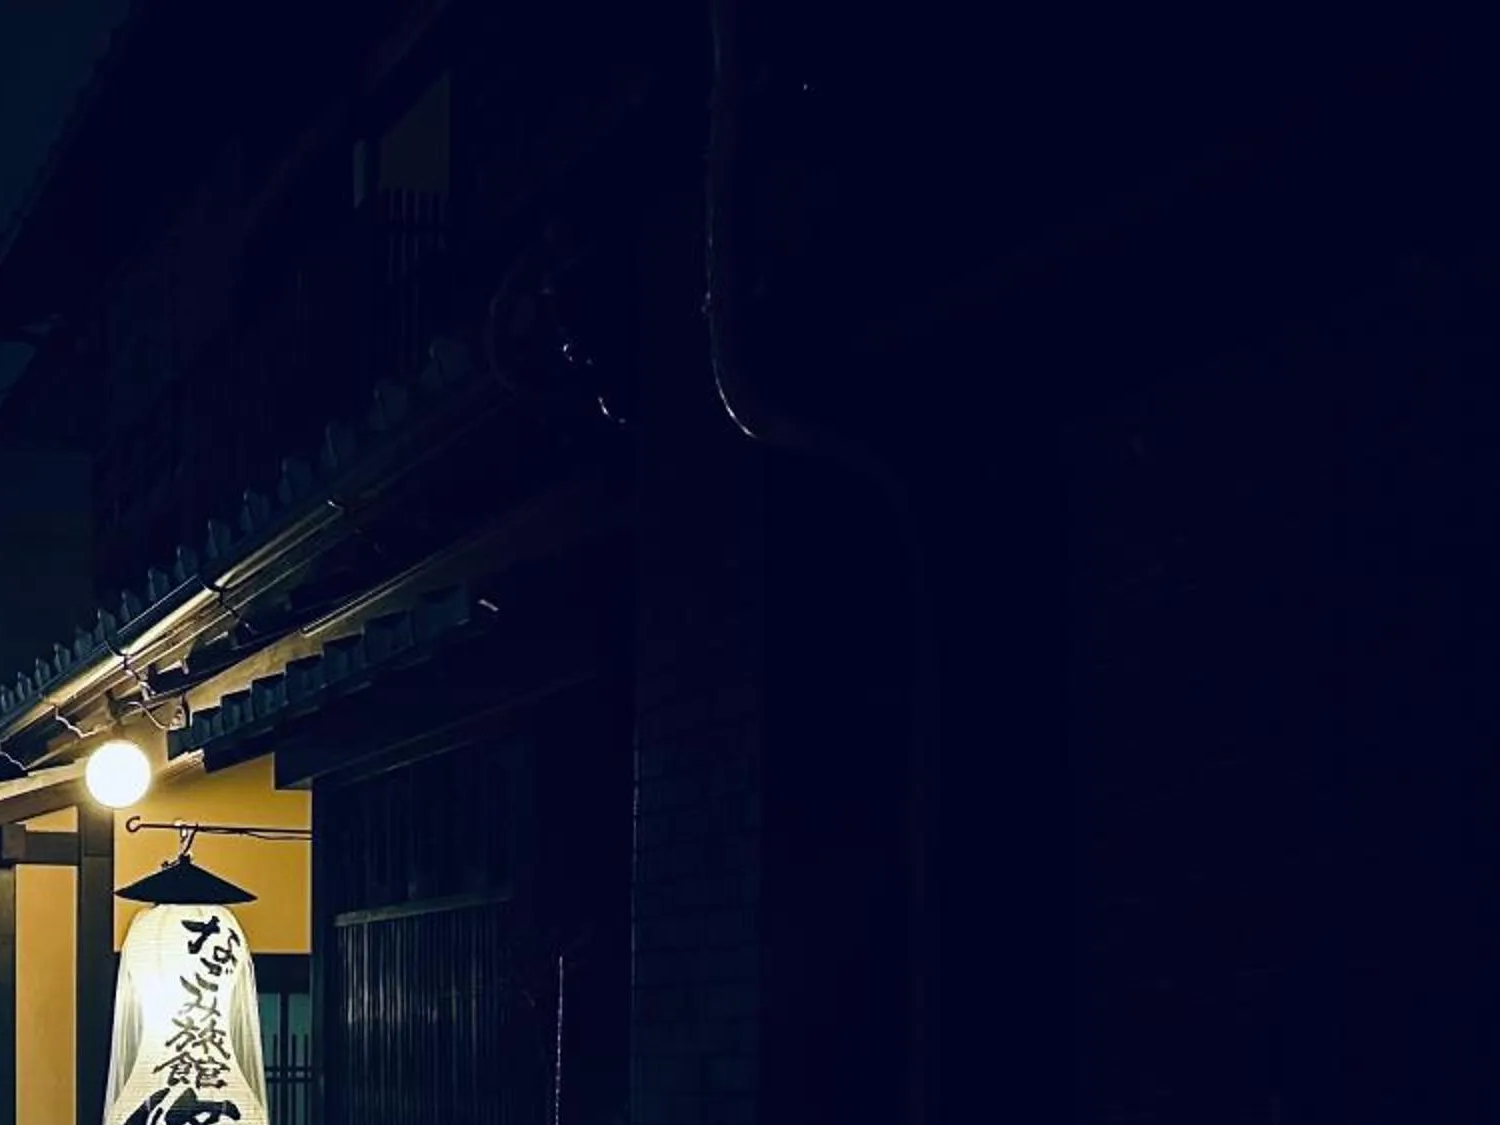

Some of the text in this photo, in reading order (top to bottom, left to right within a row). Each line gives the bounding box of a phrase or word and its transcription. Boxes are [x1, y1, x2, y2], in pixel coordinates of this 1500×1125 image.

[153, 915, 241, 1089] なごみ旅館
